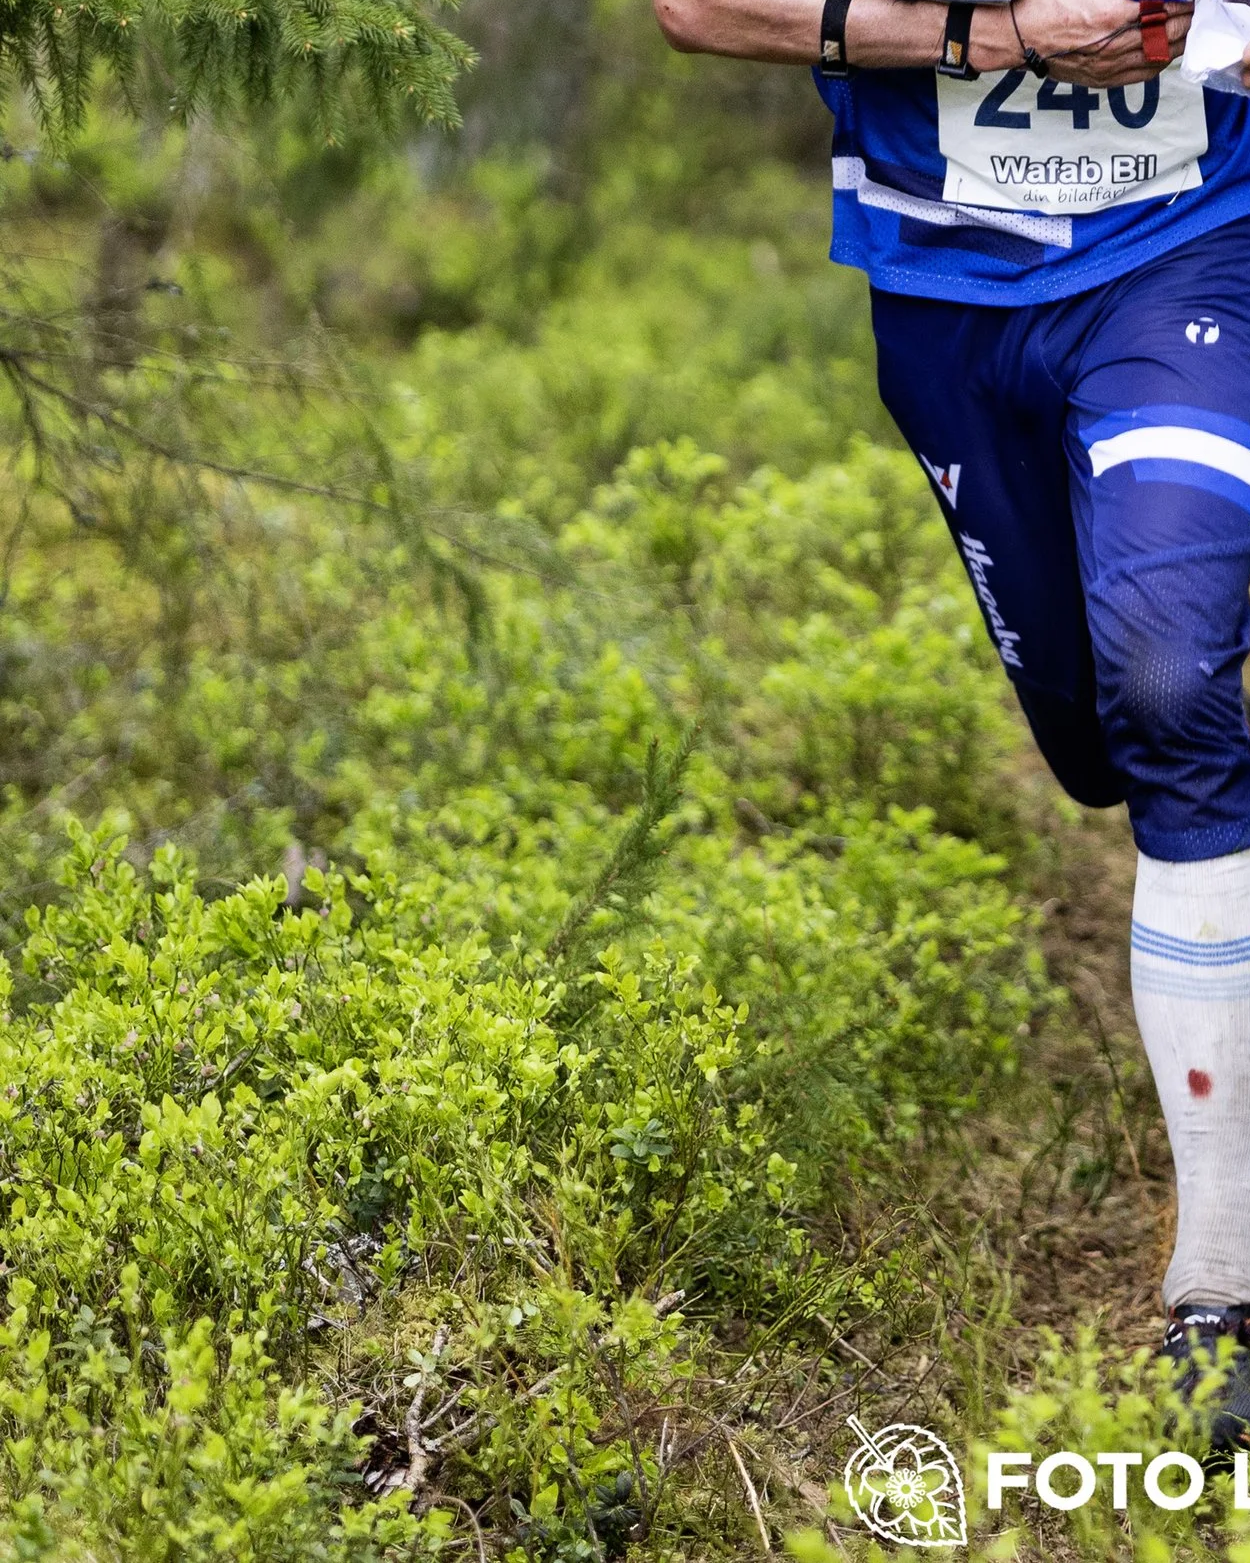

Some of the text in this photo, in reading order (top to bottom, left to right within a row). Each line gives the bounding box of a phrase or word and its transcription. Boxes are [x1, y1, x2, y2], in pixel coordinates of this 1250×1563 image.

[991, 154, 1157, 185] Wafab Bil
[1023, 187, 1050, 202] din
